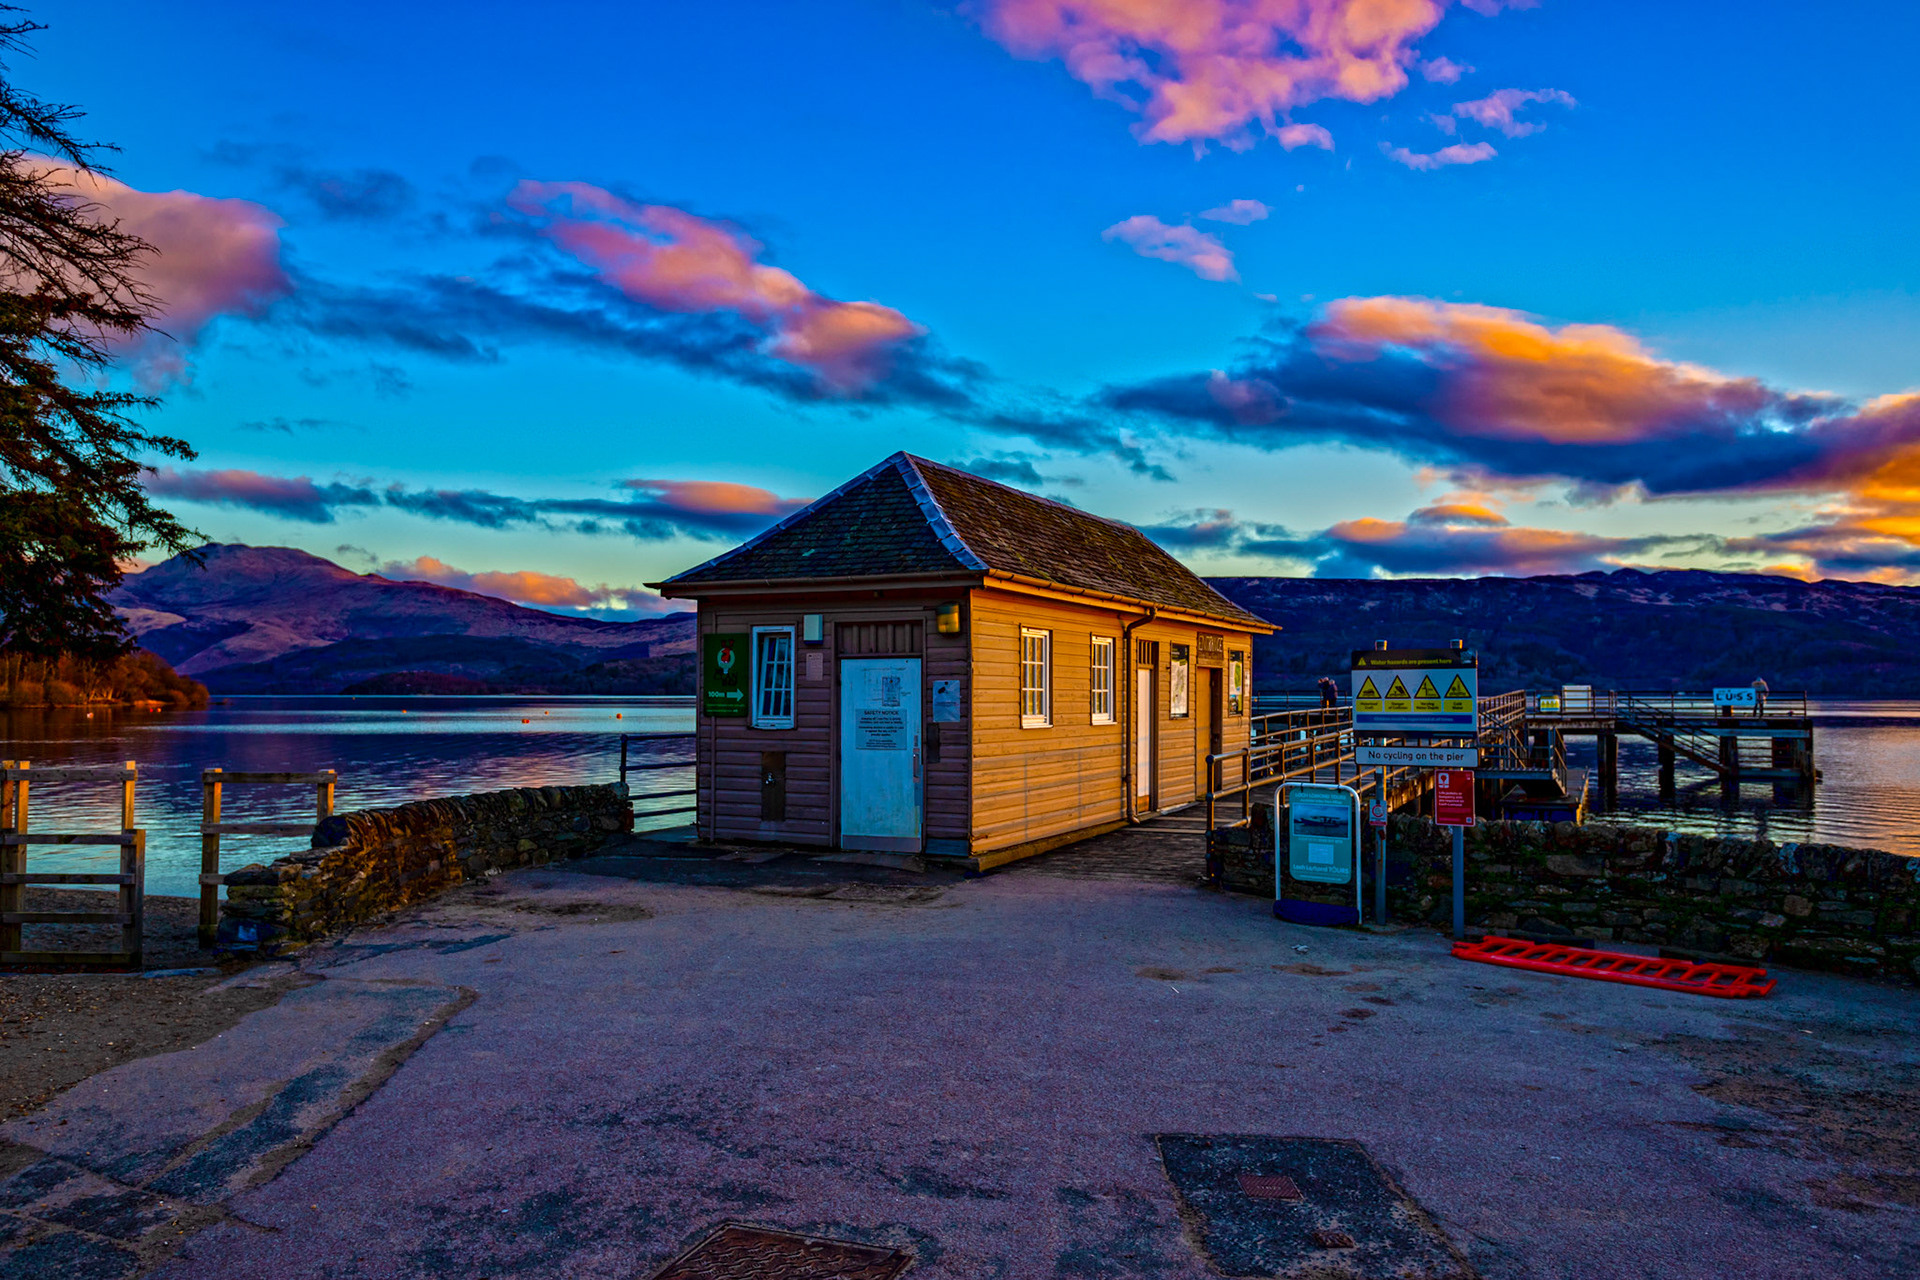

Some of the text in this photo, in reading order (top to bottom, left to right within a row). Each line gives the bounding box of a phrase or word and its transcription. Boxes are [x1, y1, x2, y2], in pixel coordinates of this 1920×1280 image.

[1369, 751, 1381, 760] No
[1383, 752, 1413, 762] cycling
[1430, 752, 1444, 761] the
[1447, 753, 1464, 762] pier
